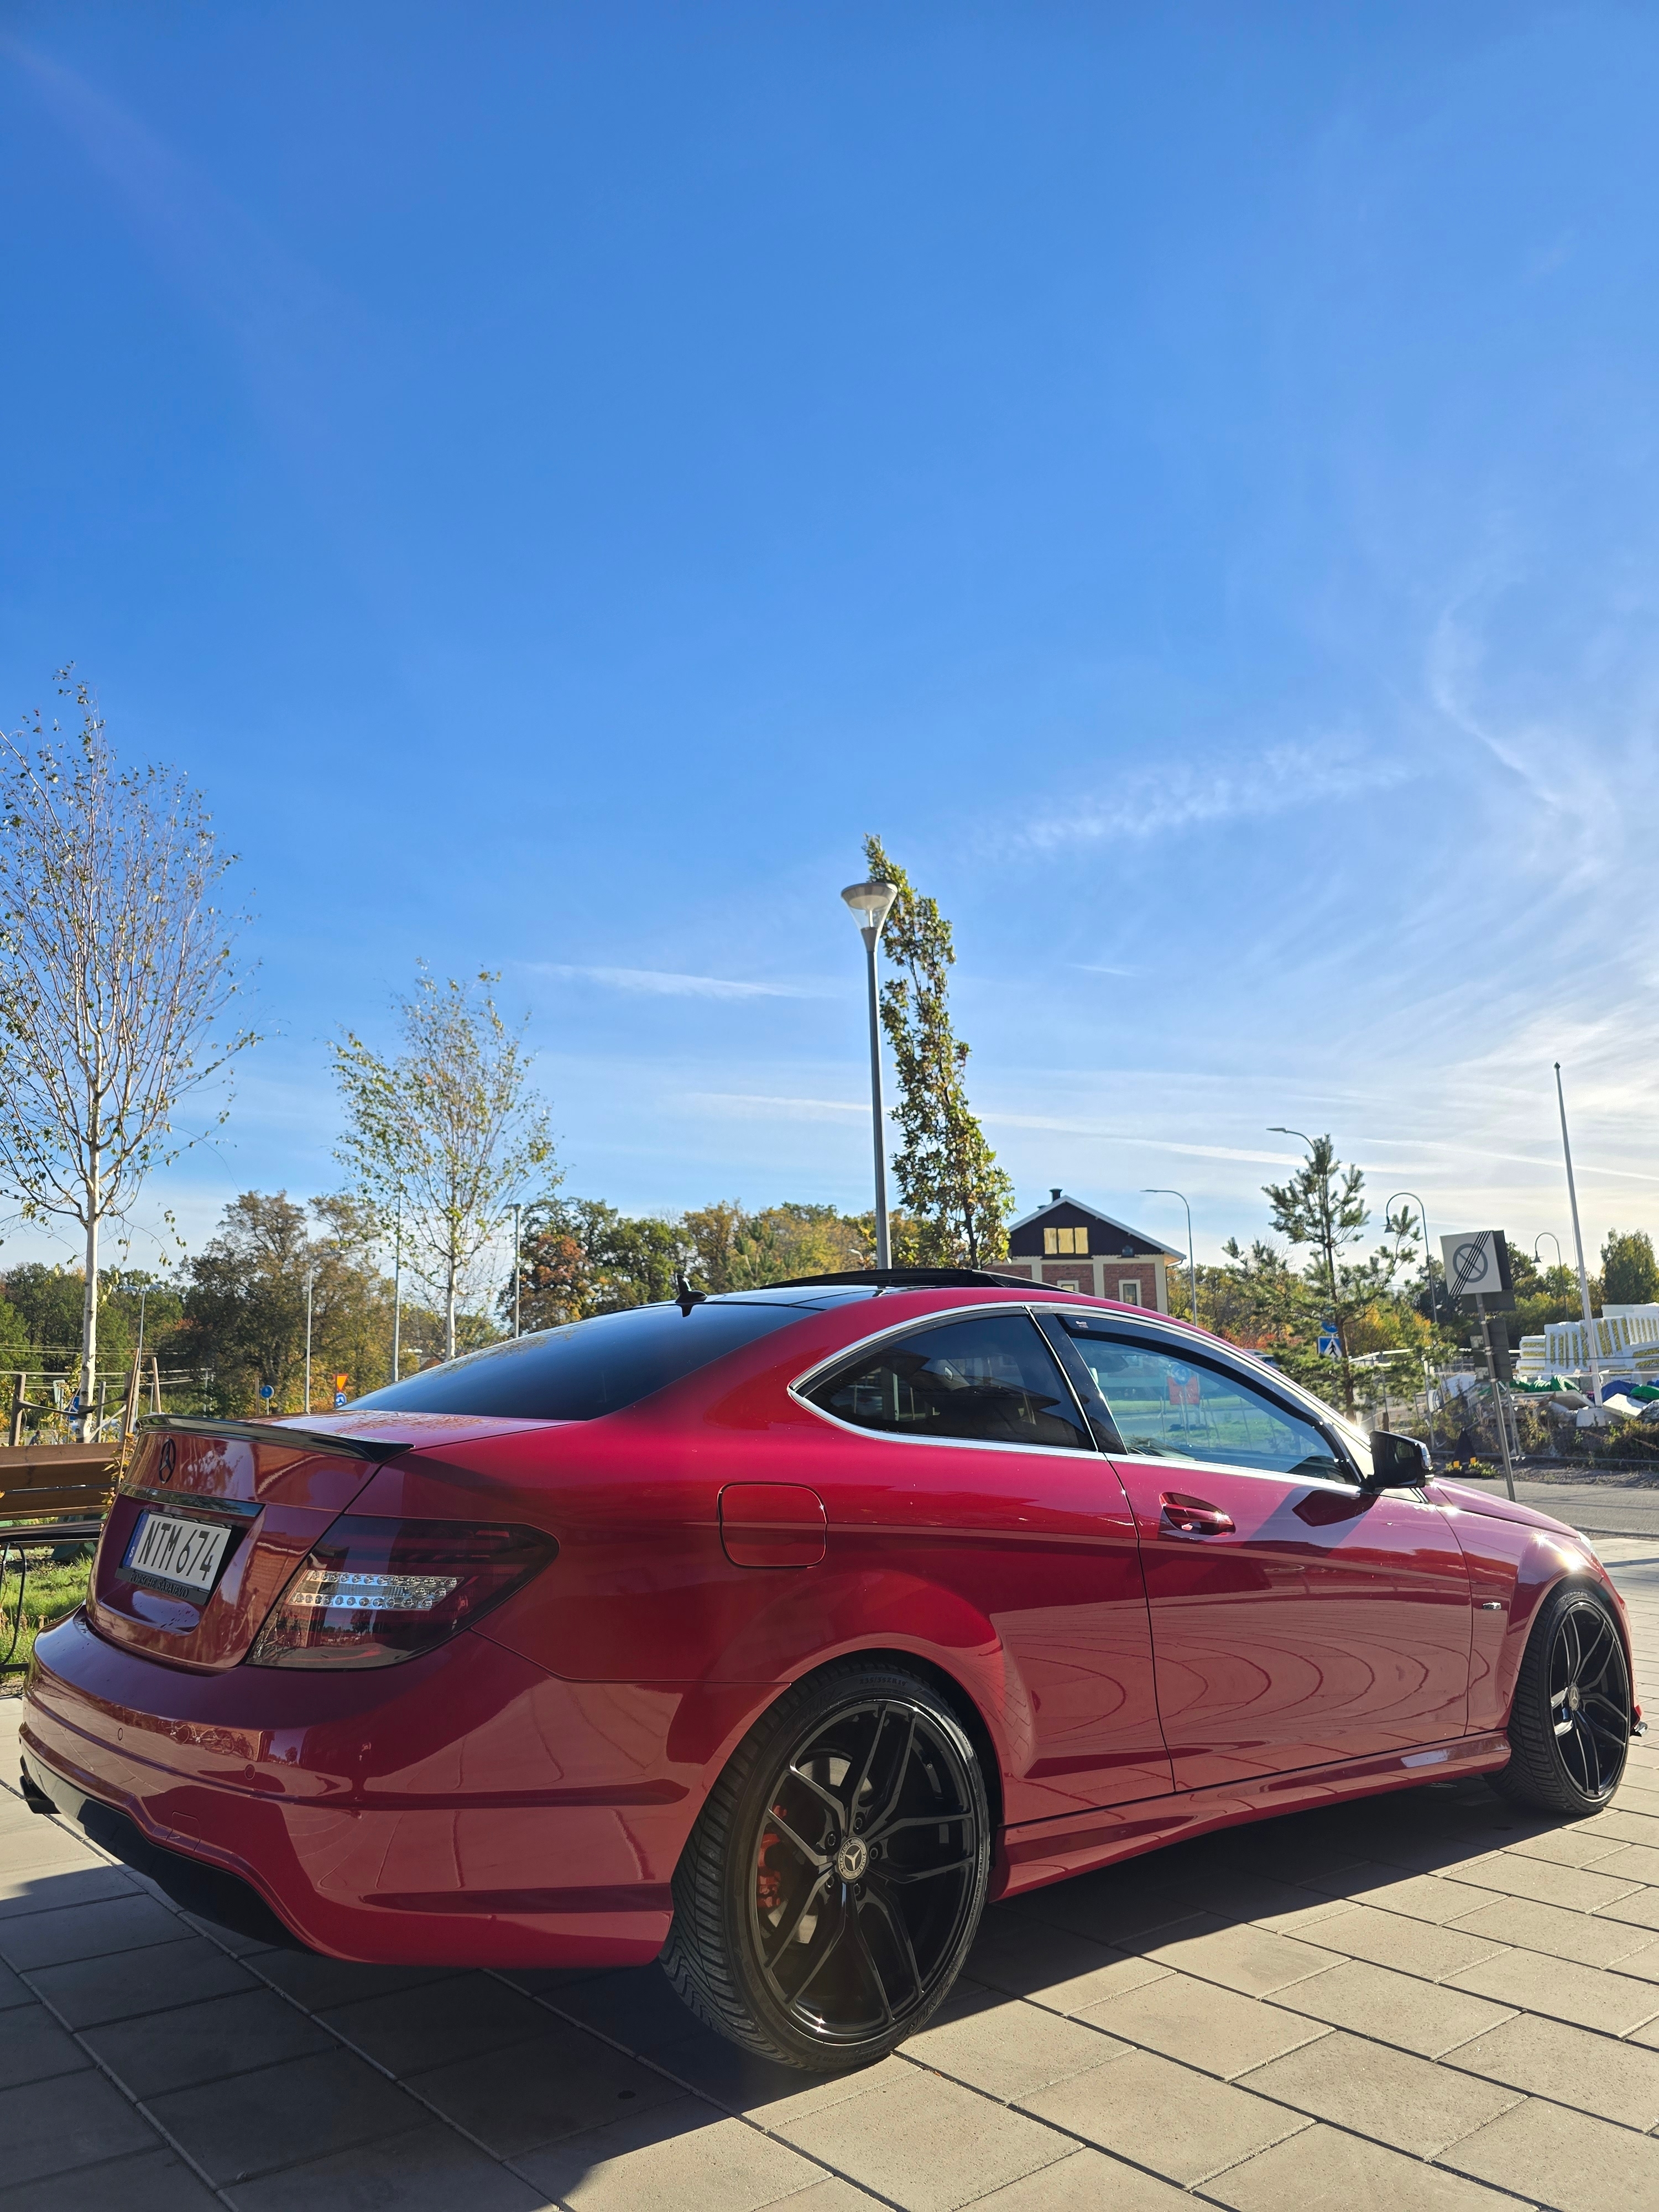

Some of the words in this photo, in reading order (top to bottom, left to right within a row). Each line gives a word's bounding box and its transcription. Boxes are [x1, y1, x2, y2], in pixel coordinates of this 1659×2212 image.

[129, 1546, 135, 1558] S
[138, 1521, 183, 1571] NTM
[176, 1529, 220, 1581] 674
[129, 1572, 156, 1587] PORSCHE
[157, 1580, 189, 1599] SARAJEVO
[840, 1841, 851, 1869] MERCEDES
